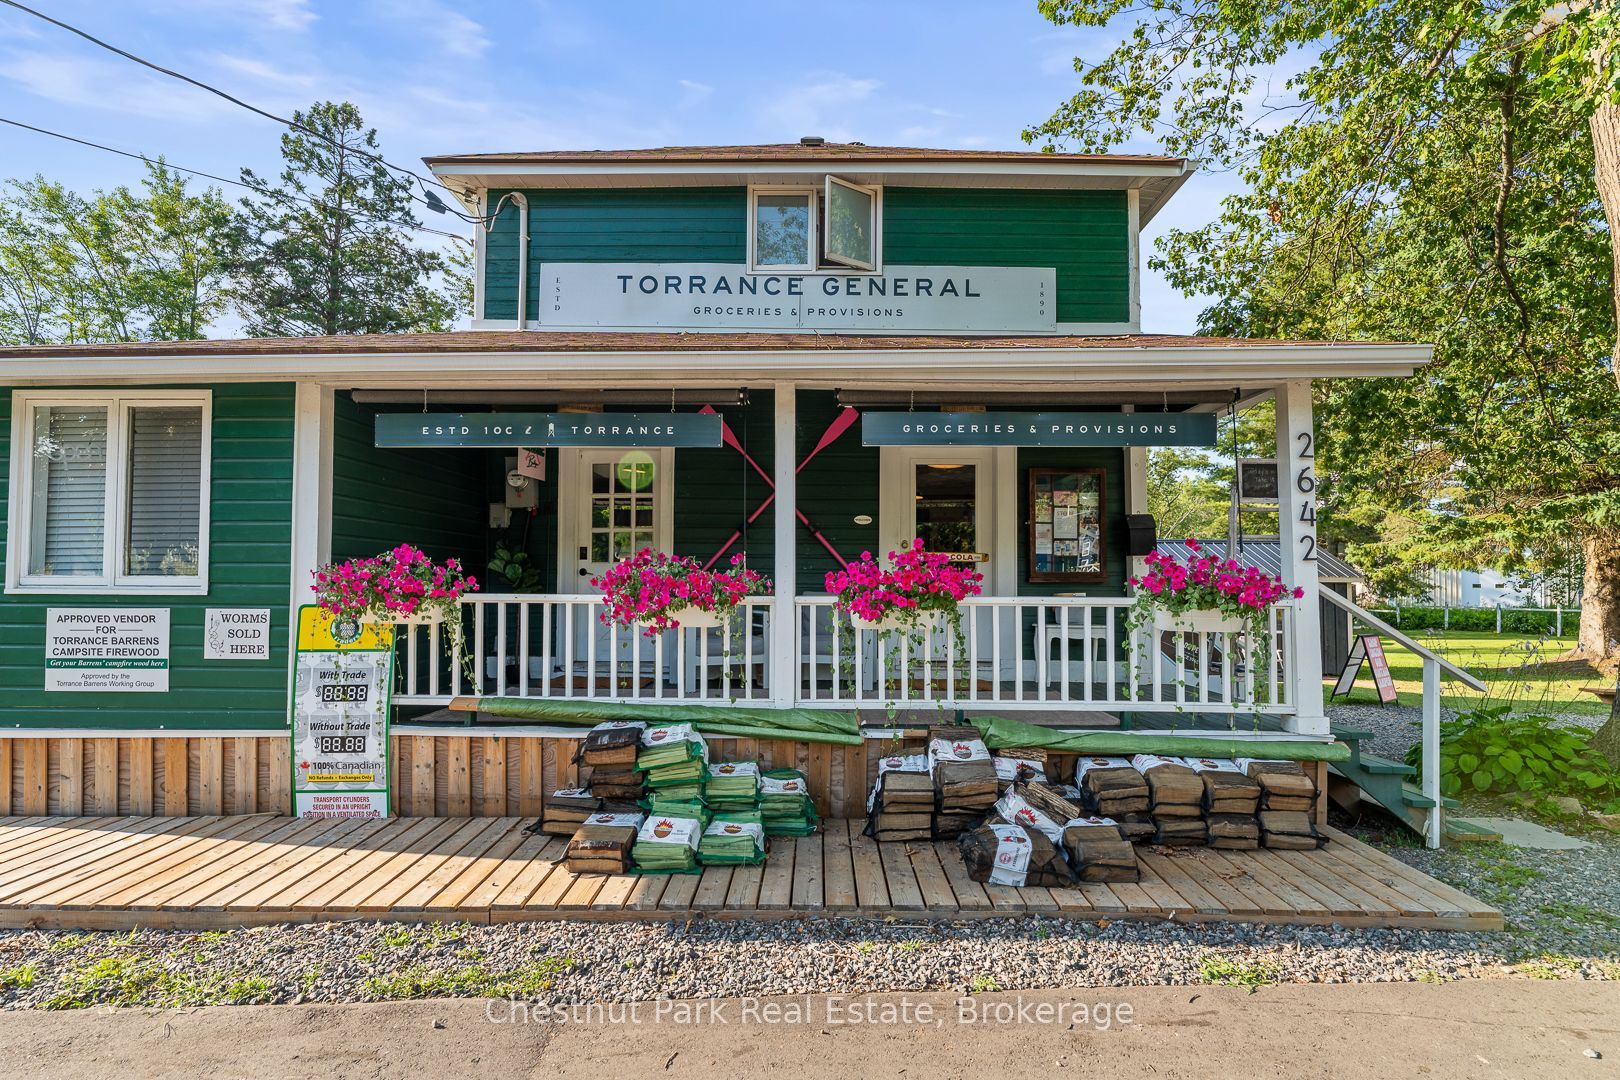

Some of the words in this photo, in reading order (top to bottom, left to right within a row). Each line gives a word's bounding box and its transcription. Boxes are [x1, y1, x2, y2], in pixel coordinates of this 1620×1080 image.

[617, 275, 804, 297] TORRANCE
[822, 277, 982, 298] GENERAL
[693, 306, 781, 316] GROCERIES
[790, 306, 800, 316] &
[807, 307, 904, 318] PROVISIONS
[422, 426, 469, 435] ESTD
[572, 426, 675, 435] TORRANCE
[902, 424, 1015, 433] GROCERIES
[1029, 425, 1037, 433] &
[1052, 425, 1177, 434] PROVISIONS
[1297, 432, 1317, 561] 2642
[56, 615, 111, 624] APPROVED
[113, 615, 156, 624] VENDOR
[221, 613, 268, 624] WORMS
[95, 626, 117, 634] FOR
[227, 629, 261, 639] SOLD
[53, 637, 108, 645] TORRANCE
[111, 637, 160, 645] BARRENS
[52, 648, 103, 656] CAMPSITE
[106, 648, 160, 656] FIREWOOD
[230, 645, 265, 654] HERE
[105, 660, 132, 668] campfire
[81, 673, 110, 681] Approved
[320, 671, 340, 680] With
[342, 671, 367, 679] Trade
[109, 680, 134, 688] Working
[310, 723, 344, 731] Without
[346, 723, 370, 731] Trade
[312, 762, 334, 770] 100%
[335, 761, 380, 770] Canadian
